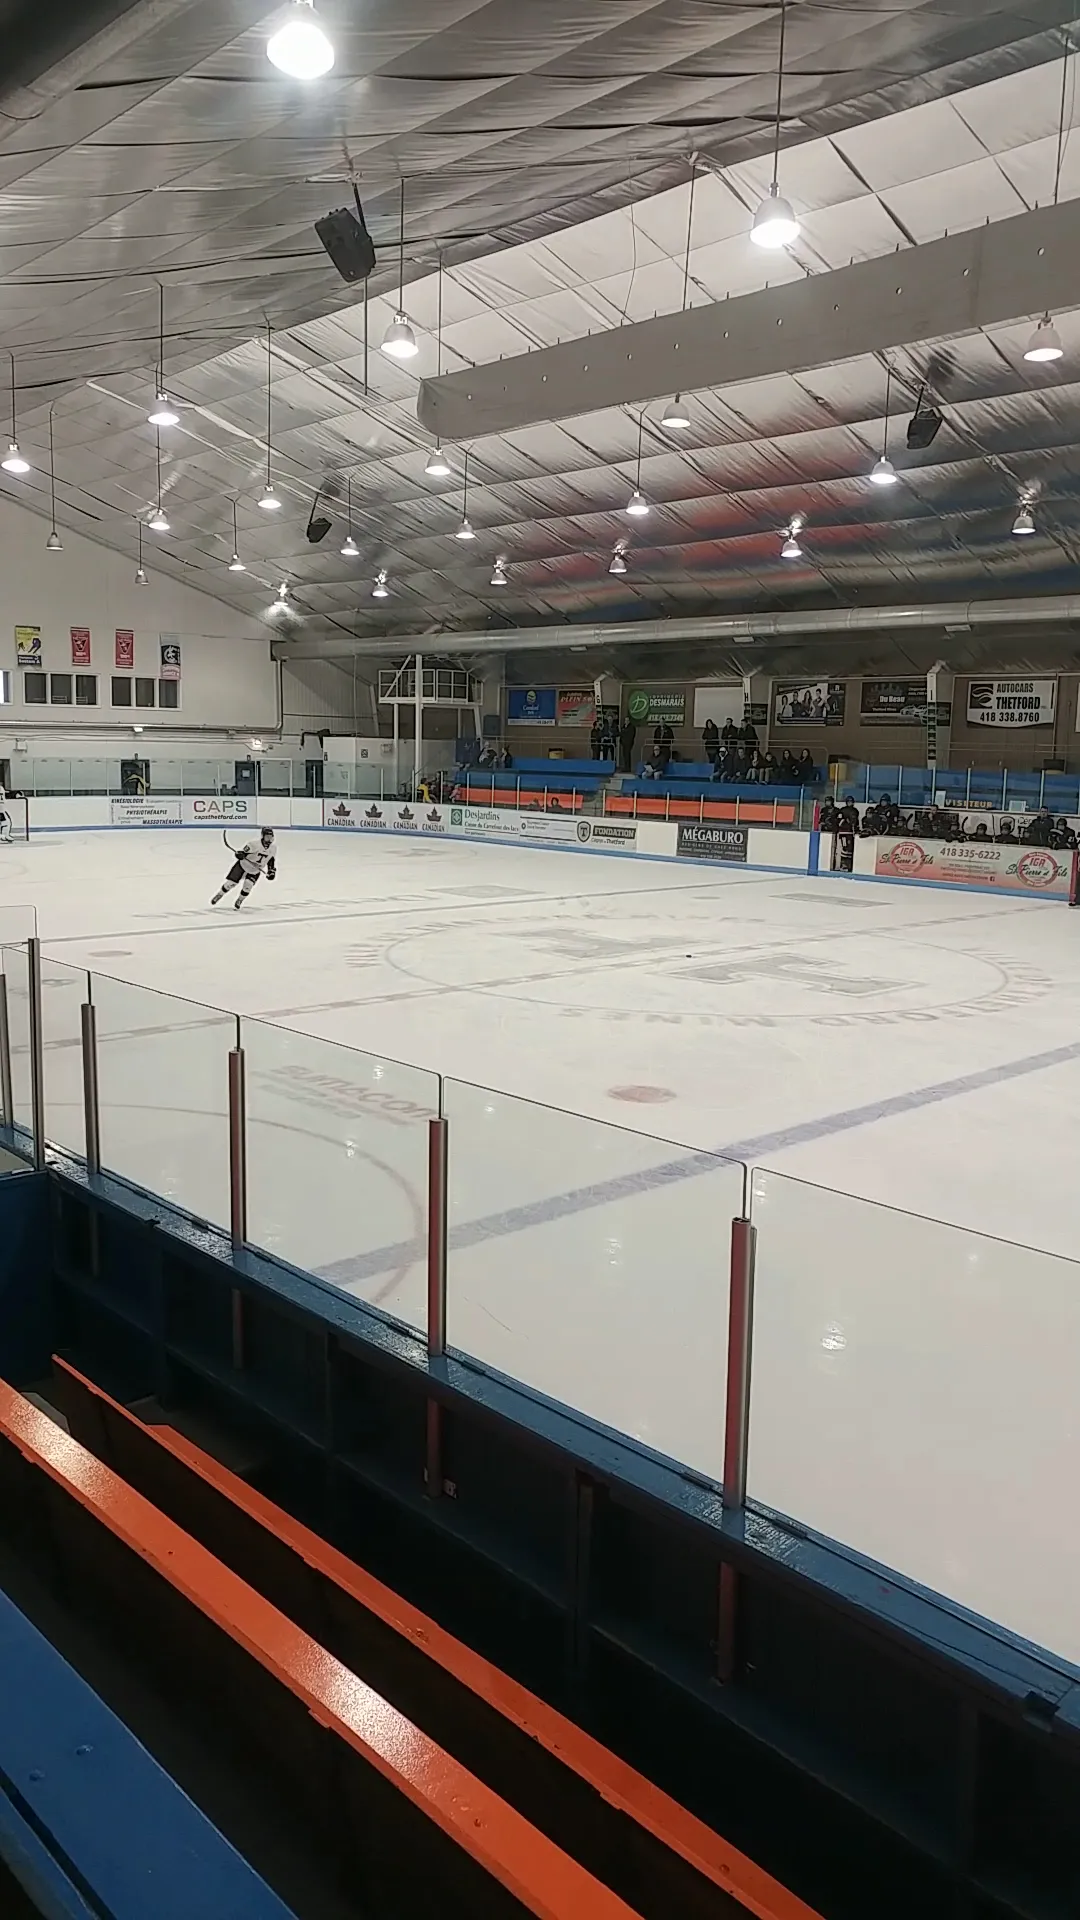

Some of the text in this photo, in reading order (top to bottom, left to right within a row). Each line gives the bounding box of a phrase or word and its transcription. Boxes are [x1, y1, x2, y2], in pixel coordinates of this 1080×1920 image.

[996, 682, 1034, 693] AUTOCARS
[649, 698, 685, 707] DESMARAIS
[995, 696, 1041, 710] THETFORD
[979, 711, 1040, 722] 418 338.8760
[193, 800, 247, 813] CAPS
[945, 800, 993, 809] VISITEUR
[464, 808, 500, 821] Desjardins
[327, 818, 355, 827] CANADIAN
[360, 819, 387, 829] CANADIAN
[393, 821, 418, 831] CANADIAN
[421, 823, 445, 833] CANADIAN
[594, 827, 636, 838] FONDATION
[681, 826, 744, 844] MÉGABURO
[900, 847, 915, 857] IGA
[939, 847, 1001, 861] 418 335-6222
[256, 852, 269, 864] T
[1030, 857, 1046, 868] IGA
